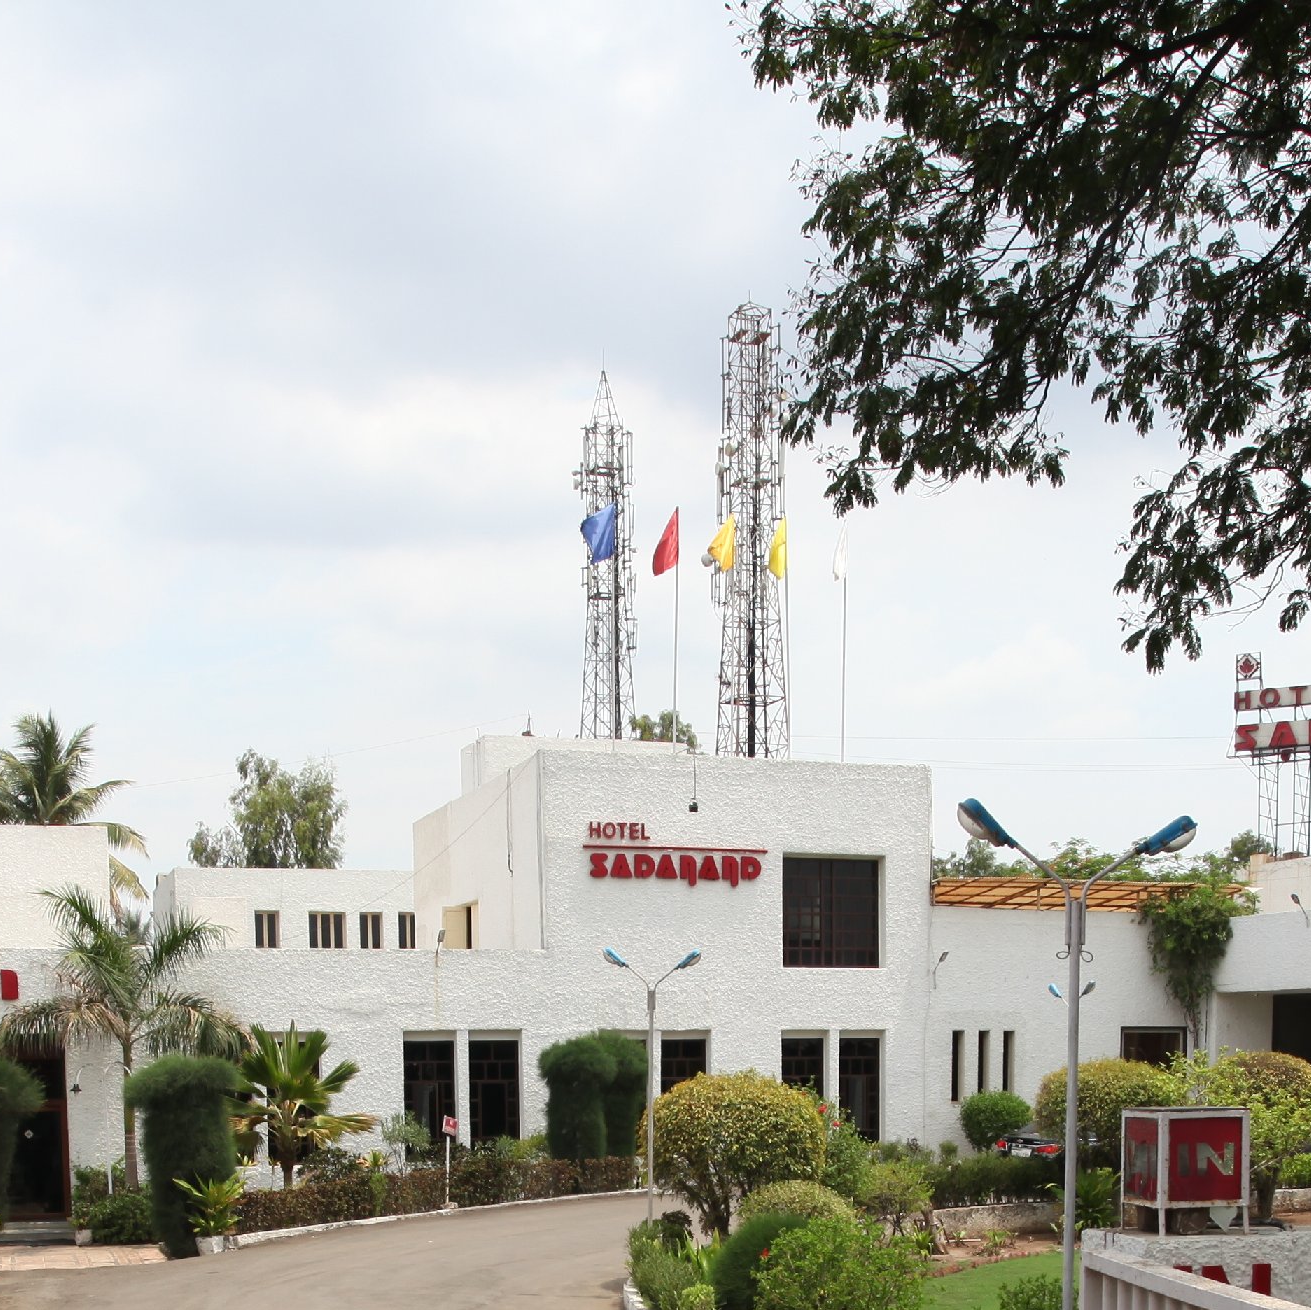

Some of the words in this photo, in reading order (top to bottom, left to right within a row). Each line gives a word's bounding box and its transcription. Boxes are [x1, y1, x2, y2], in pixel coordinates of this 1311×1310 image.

[589, 821, 650, 841] HOTEL
[590, 853, 762, 887] SADANAND
[1177, 1142, 1235, 1176] IN
